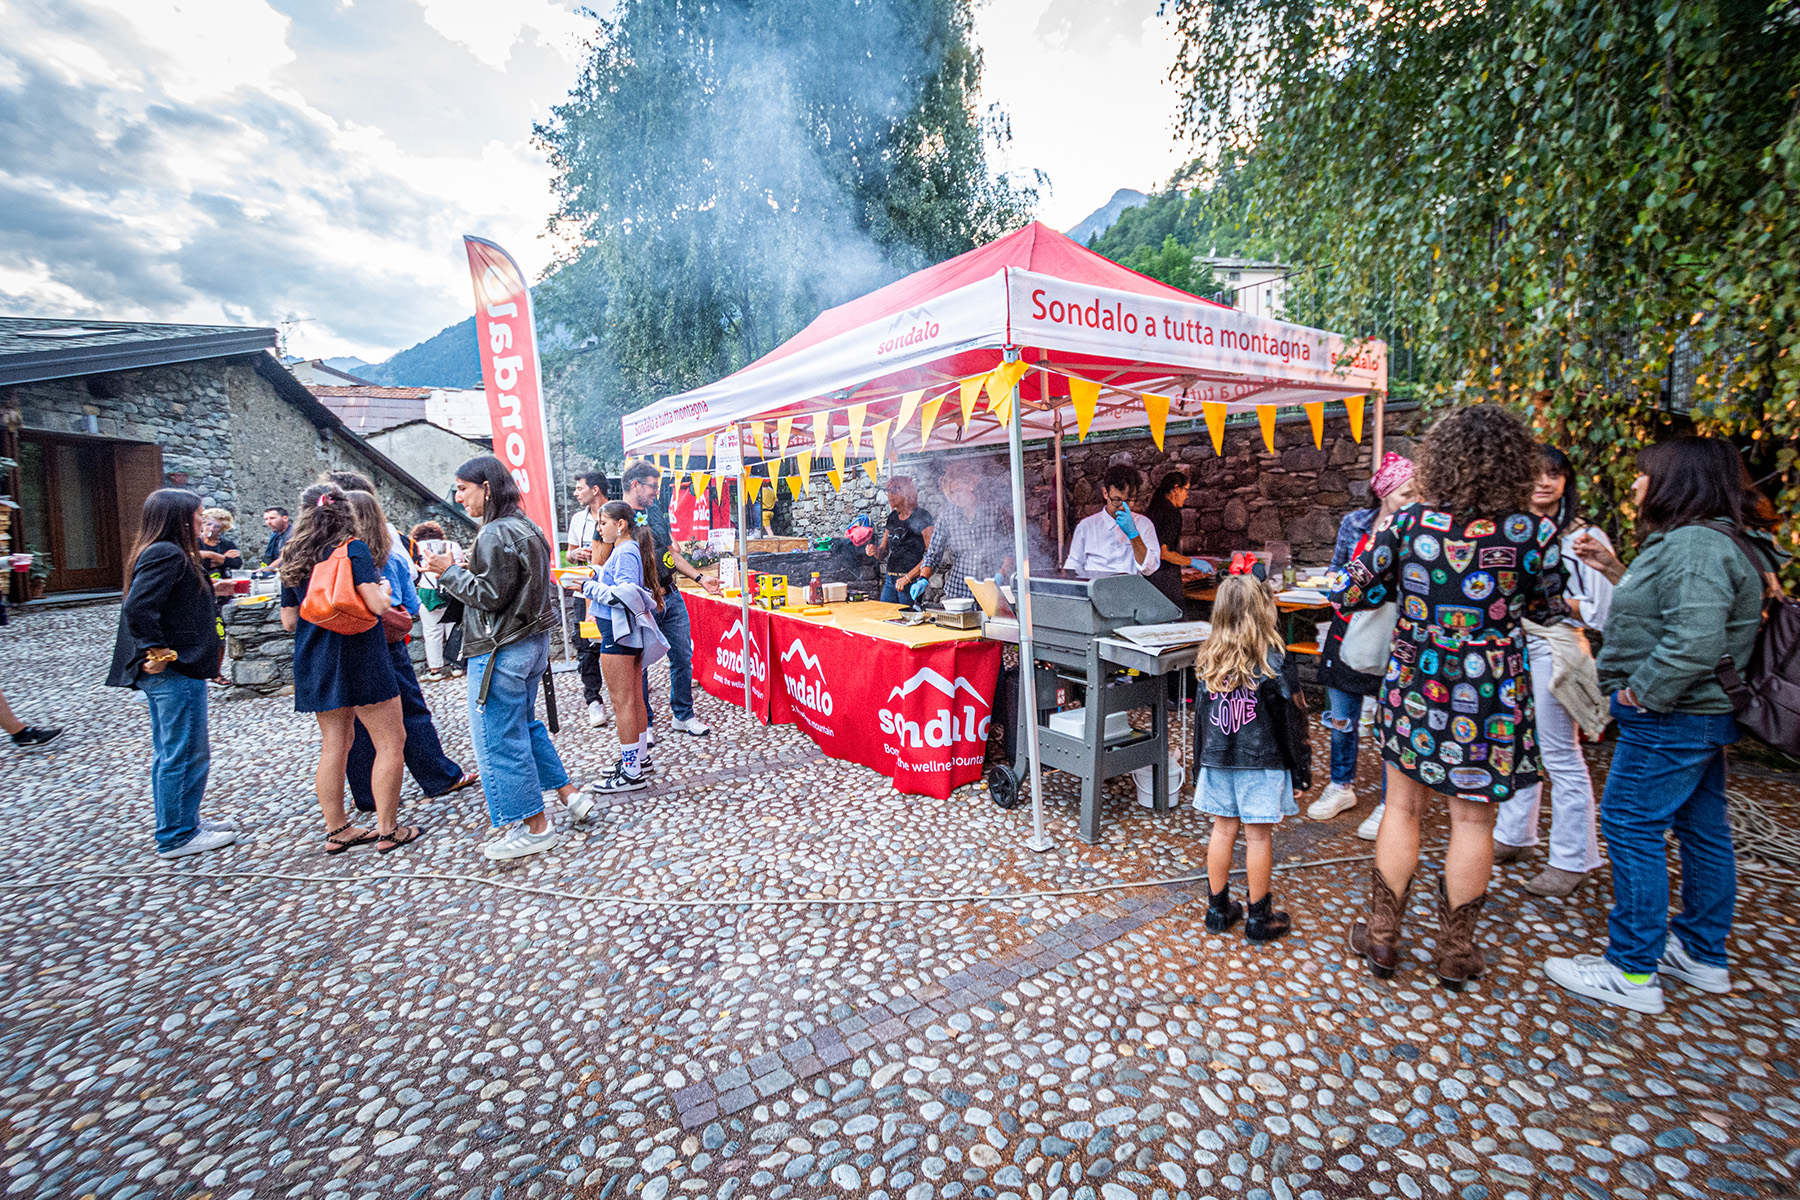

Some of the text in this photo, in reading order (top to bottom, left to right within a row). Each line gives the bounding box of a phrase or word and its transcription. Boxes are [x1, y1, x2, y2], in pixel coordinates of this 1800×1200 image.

[877, 321, 940, 355] sondalo
[1032, 289, 1311, 363] Sondalo a tutta montagna
[1331, 353, 1379, 371] sdalo
[634, 416, 655, 437] Sondalo
[658, 411, 674, 427] tutta
[674, 400, 708, 420] montagna
[716, 647, 766, 682] sondalo
[784, 673, 833, 717] ndalo
[1210, 698, 1257, 736] LOVE
[897, 755, 984, 773] the wellne ounta
